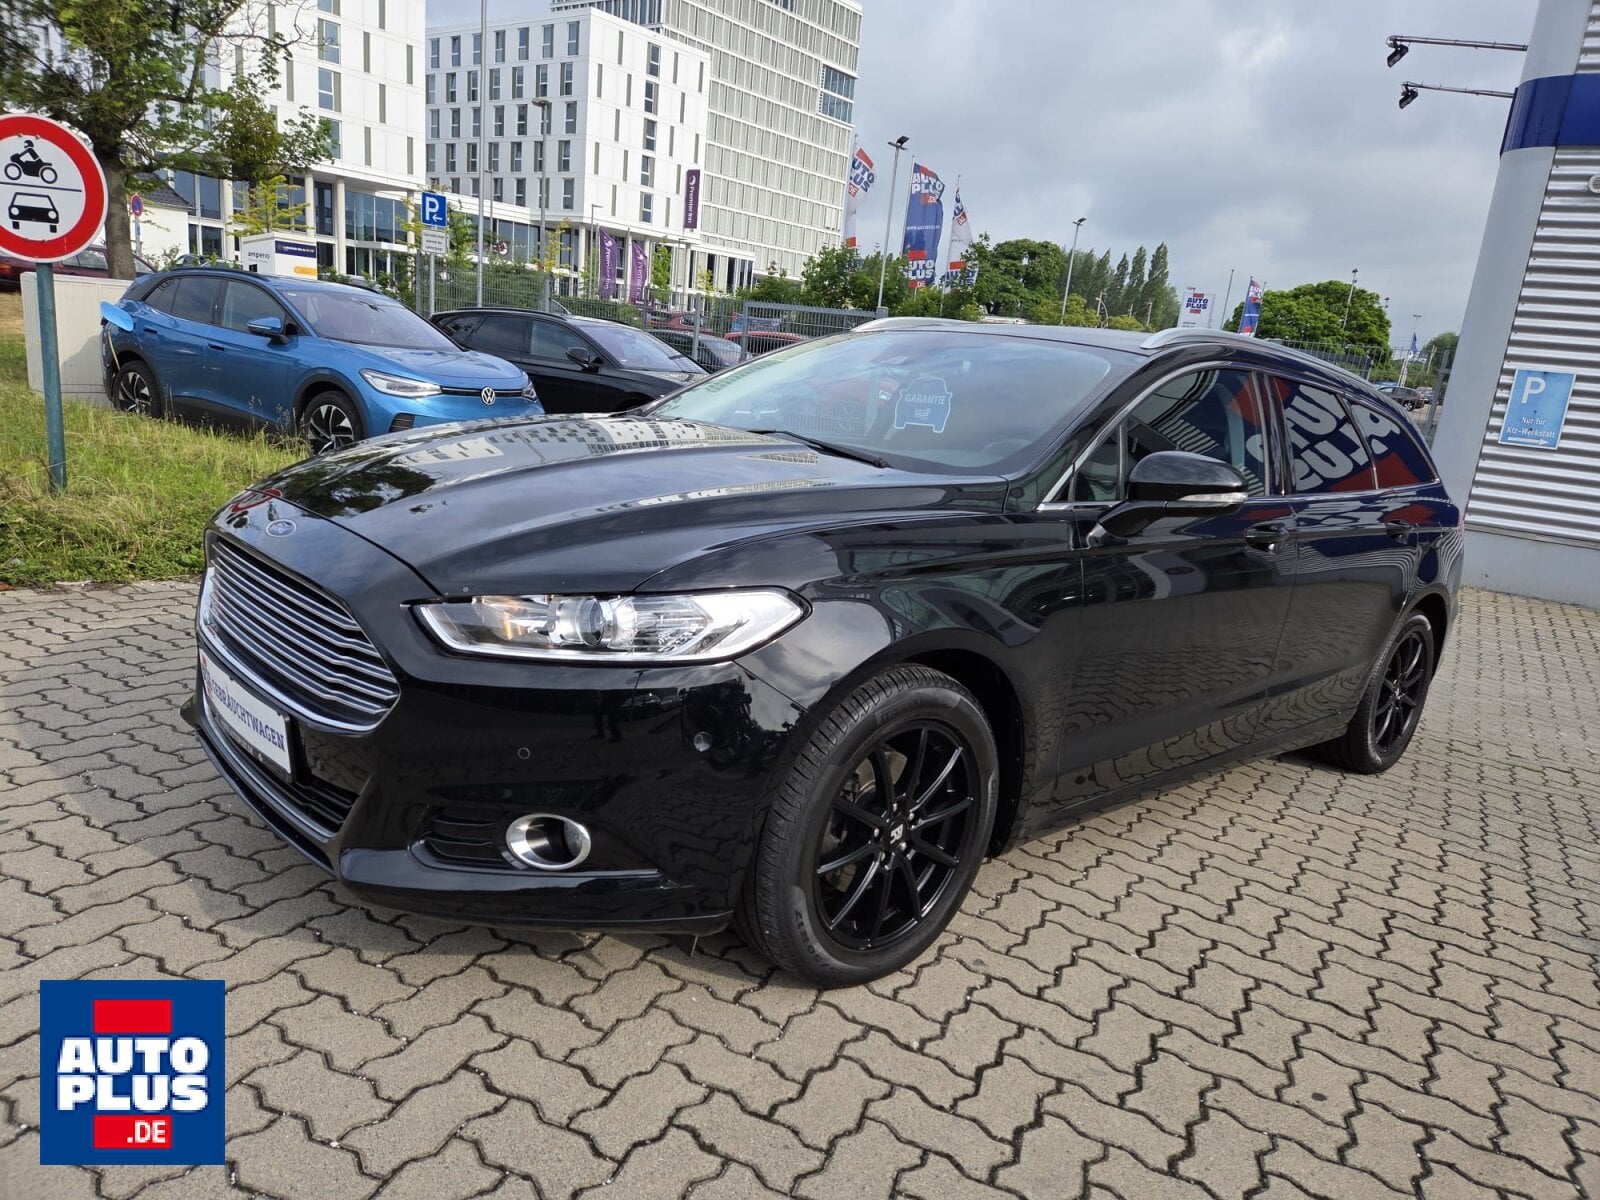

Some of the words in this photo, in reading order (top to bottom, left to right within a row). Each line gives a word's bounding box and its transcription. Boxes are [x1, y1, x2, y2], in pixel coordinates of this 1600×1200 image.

[911, 172, 944, 192] AUTO
[425, 196, 440, 221] P
[905, 393, 947, 405] GARANTIE
[1521, 376, 1547, 405] P
[1521, 415, 1534, 425] Nur
[1535, 416, 1547, 426] für
[1506, 425, 1556, 439] Kfz-Werkstatt
[212, 680, 286, 752] GEBRAUCHTWAGEN
